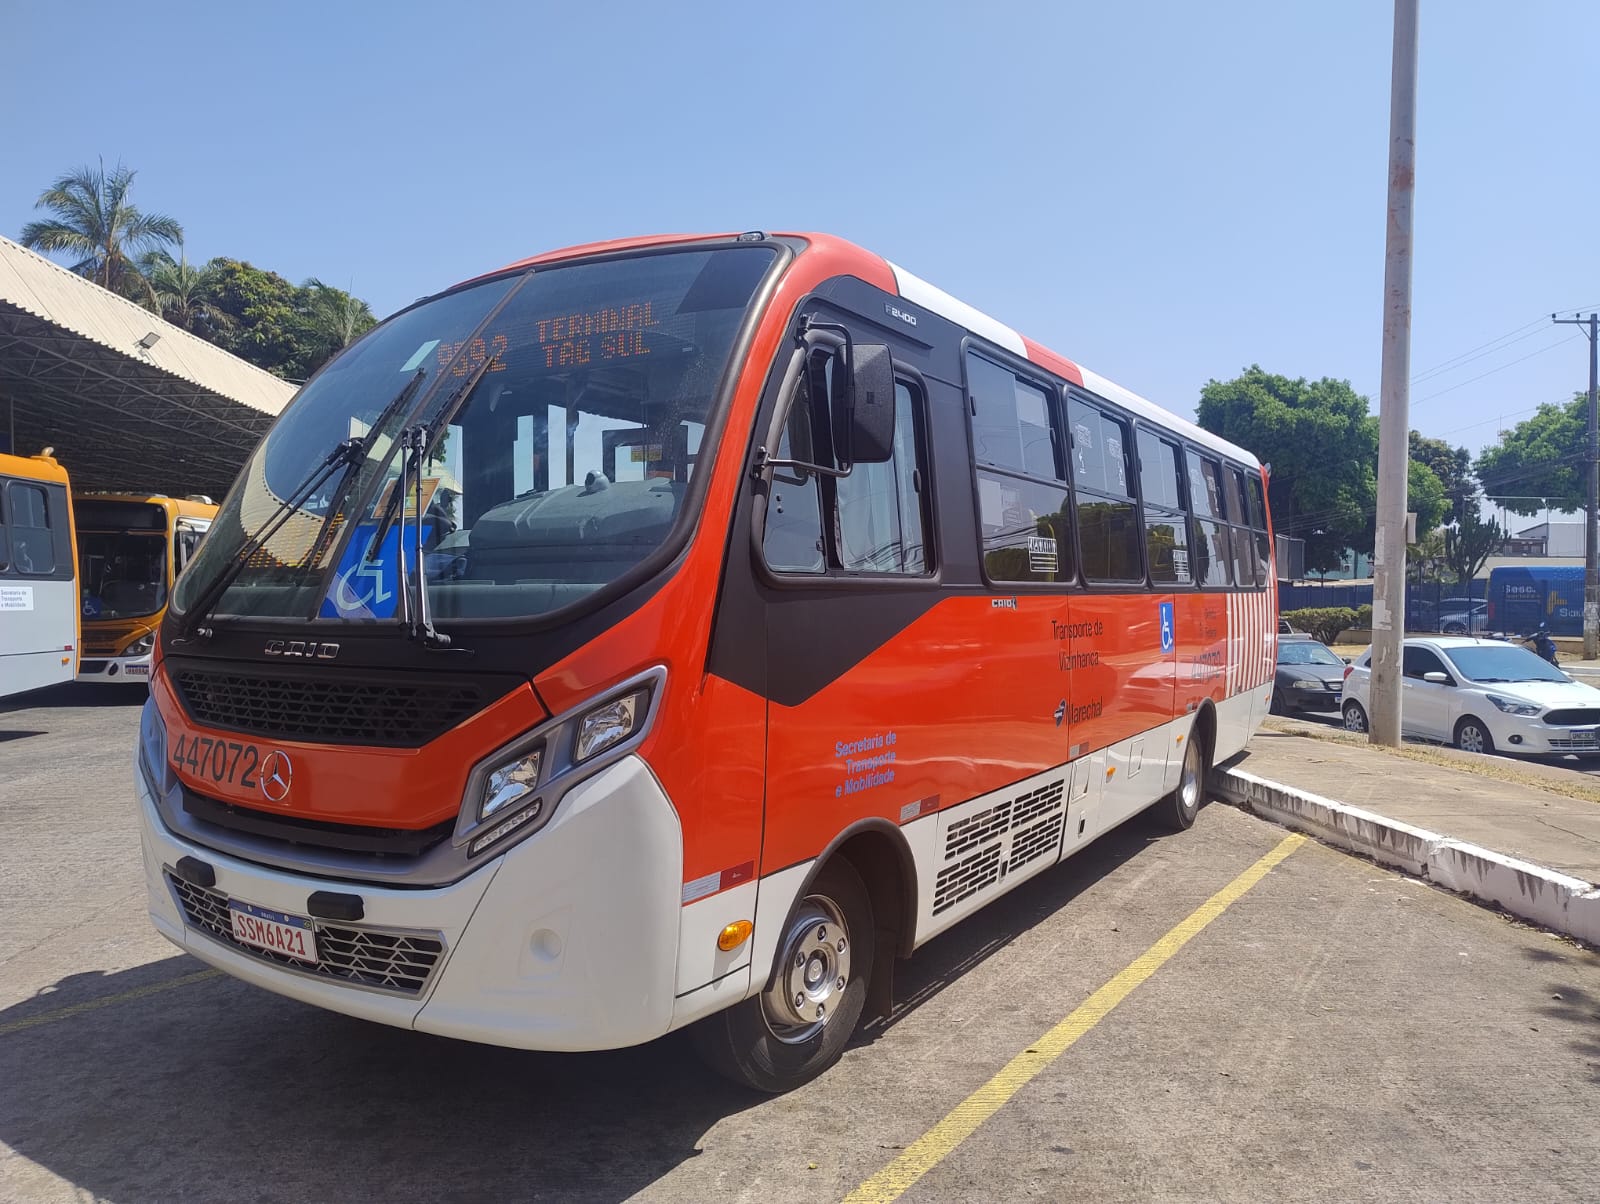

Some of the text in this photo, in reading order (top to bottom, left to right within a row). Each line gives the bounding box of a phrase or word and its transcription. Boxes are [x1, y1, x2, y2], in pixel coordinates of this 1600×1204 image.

[535, 301, 660, 343] TERMINAL
[884, 304, 917, 326] F2400
[542, 328, 651, 368] TAG SUL
[992, 598, 1011, 608] CAIO
[1051, 617, 1103, 644] Transporte de
[1066, 695, 1103, 726] Marechal
[835, 729, 897, 758] Secretaria de
[173, 733, 259, 788] 447072
[846, 750, 896, 775] Transporte
[835, 768, 895, 798] e Mobilidade
[238, 915, 306, 956] SSM6A21
